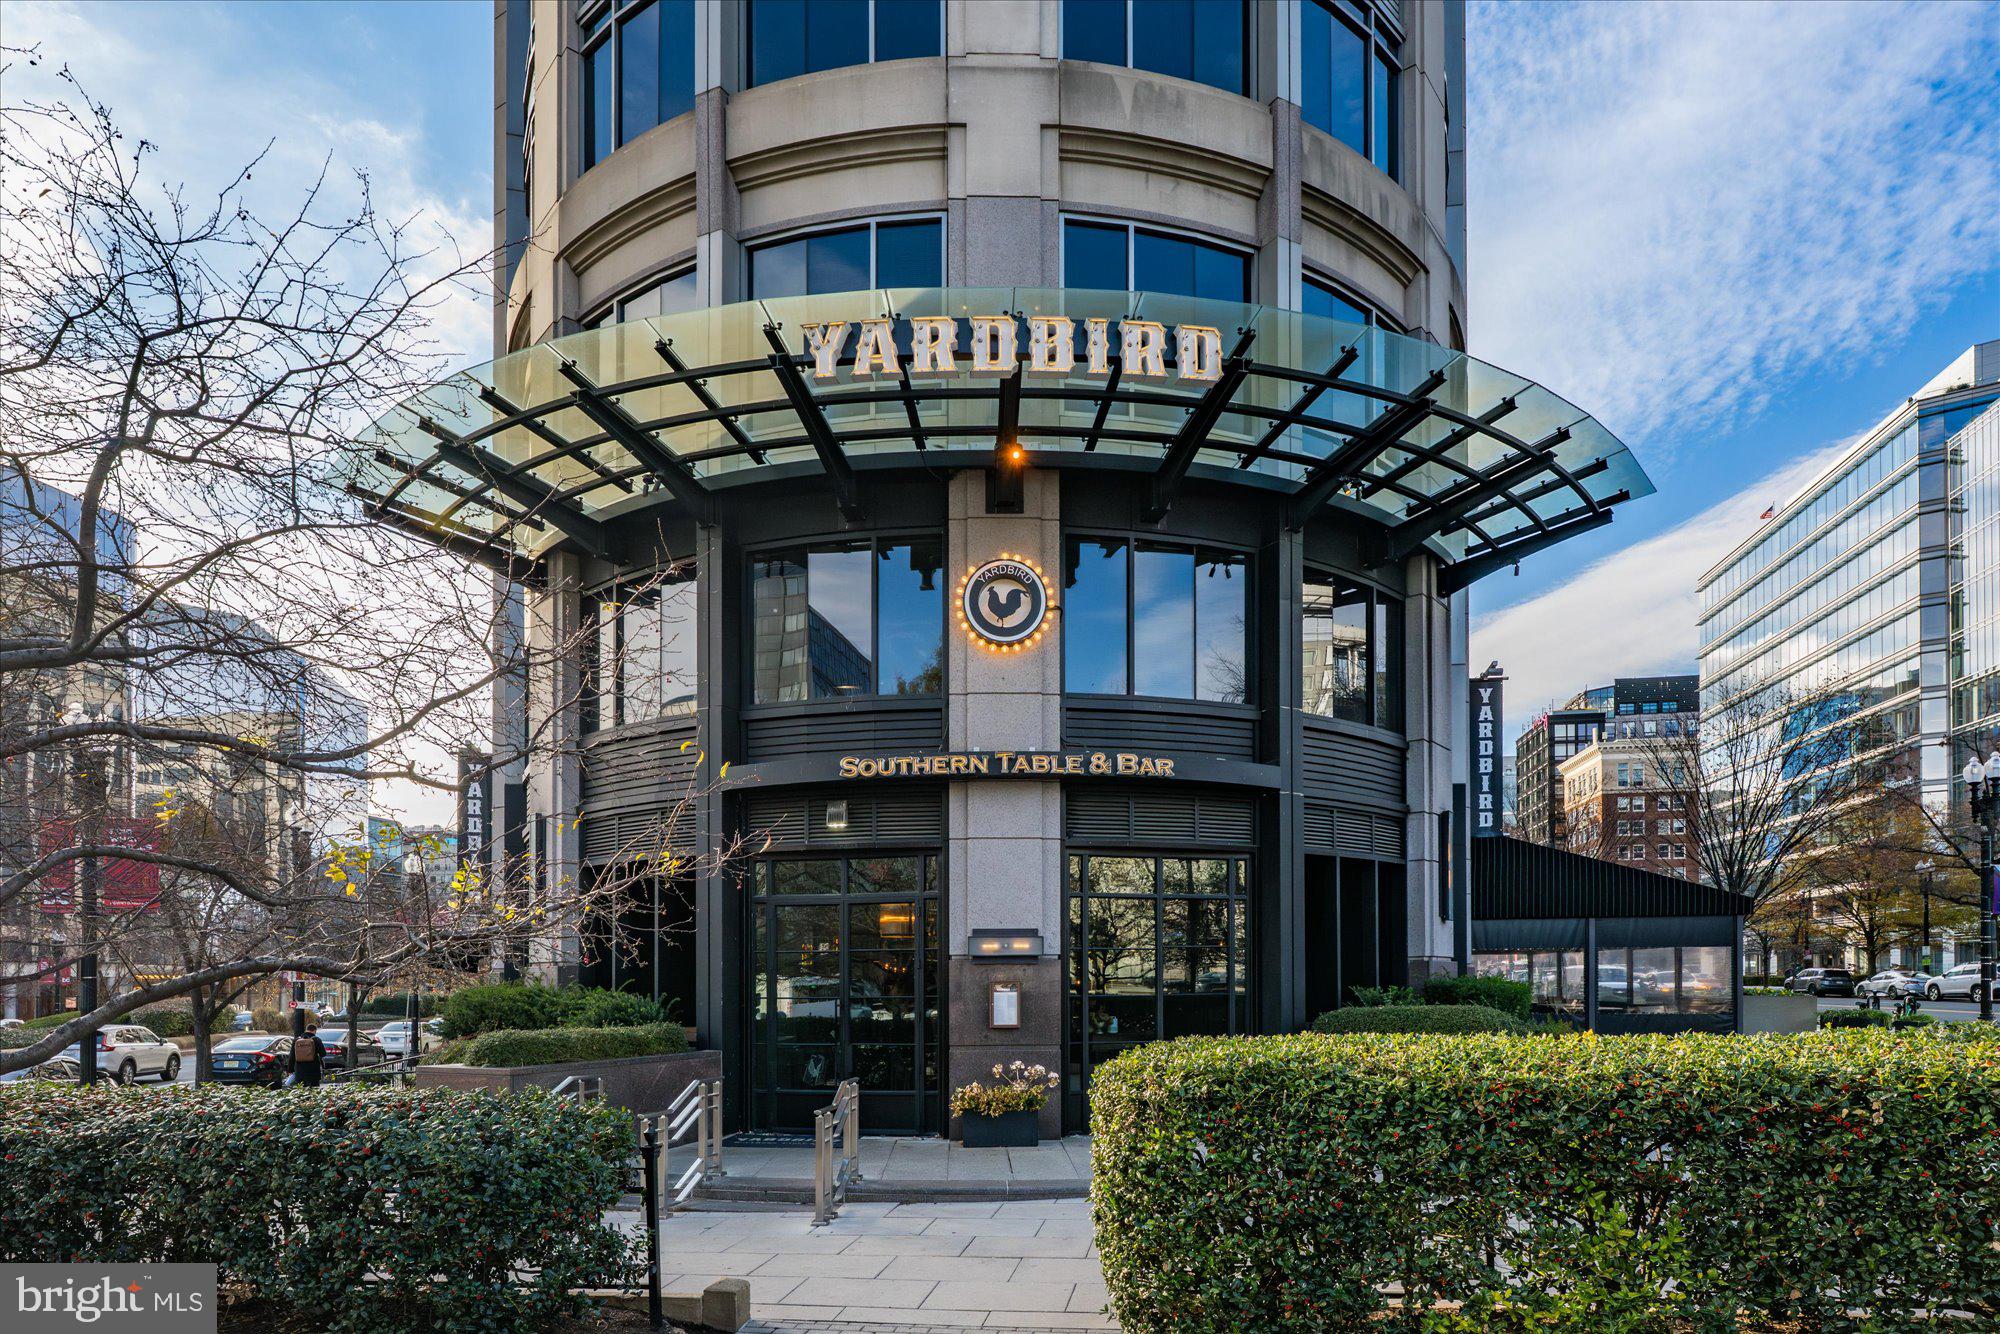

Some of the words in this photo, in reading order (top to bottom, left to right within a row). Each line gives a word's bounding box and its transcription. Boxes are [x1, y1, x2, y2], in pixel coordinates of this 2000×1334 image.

[801, 315, 1224, 386] YARDBIRD
[977, 565, 1033, 584] YARDBIRD
[839, 754, 989, 778] SOUTHERN
[995, 750, 1084, 775] TABLE
[1089, 751, 1112, 774] &
[1117, 753, 1175, 777] BAR
[1478, 688, 1494, 828] YARDBIRD
